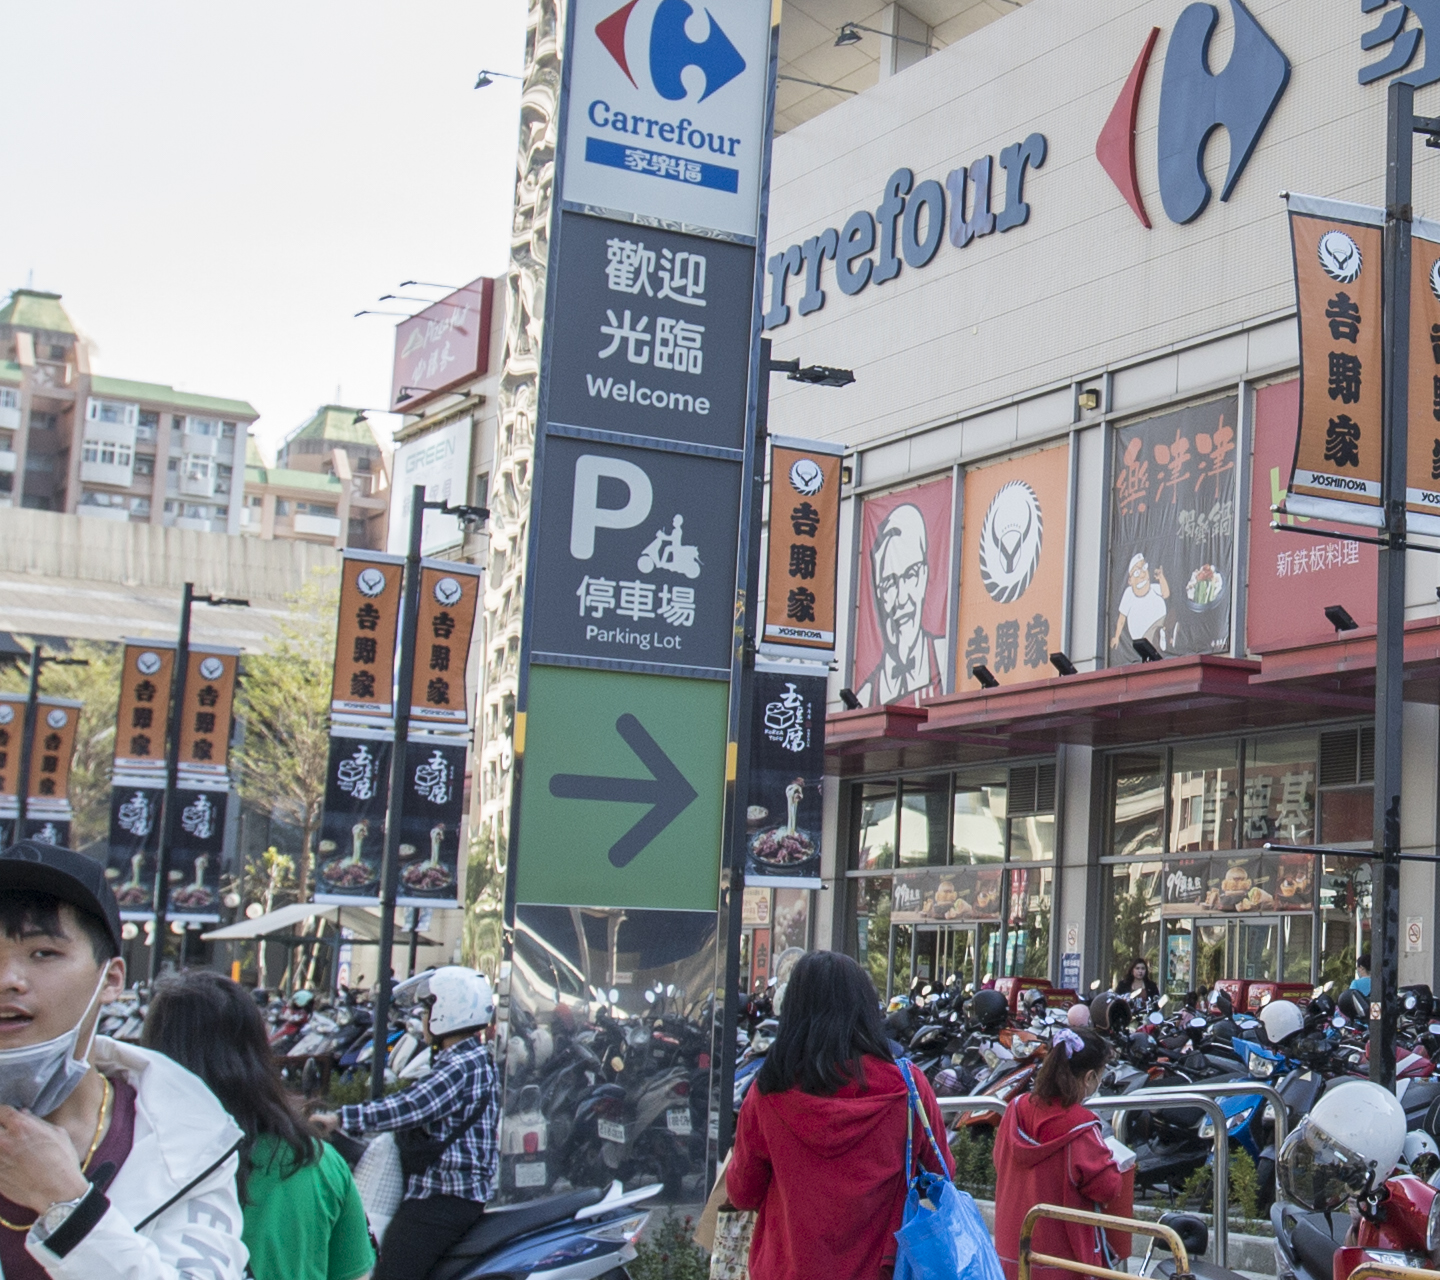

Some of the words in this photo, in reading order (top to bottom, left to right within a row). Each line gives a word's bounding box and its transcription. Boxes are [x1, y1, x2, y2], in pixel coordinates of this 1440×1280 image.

[587, 99, 742, 158] Carrefour
[623, 148, 703, 184] 家樂福
[760, 130, 1049, 330] rrefour
[604, 237, 708, 307] 歡迎
[597, 308, 706, 375] 光臨
[585, 373, 711, 416] Welcome
[405, 436, 457, 474] GREEN
[570, 453, 654, 561] P
[576, 574, 696, 628] 停車場
[586, 624, 652, 651] Parking
[653, 630, 683, 651] Lot
